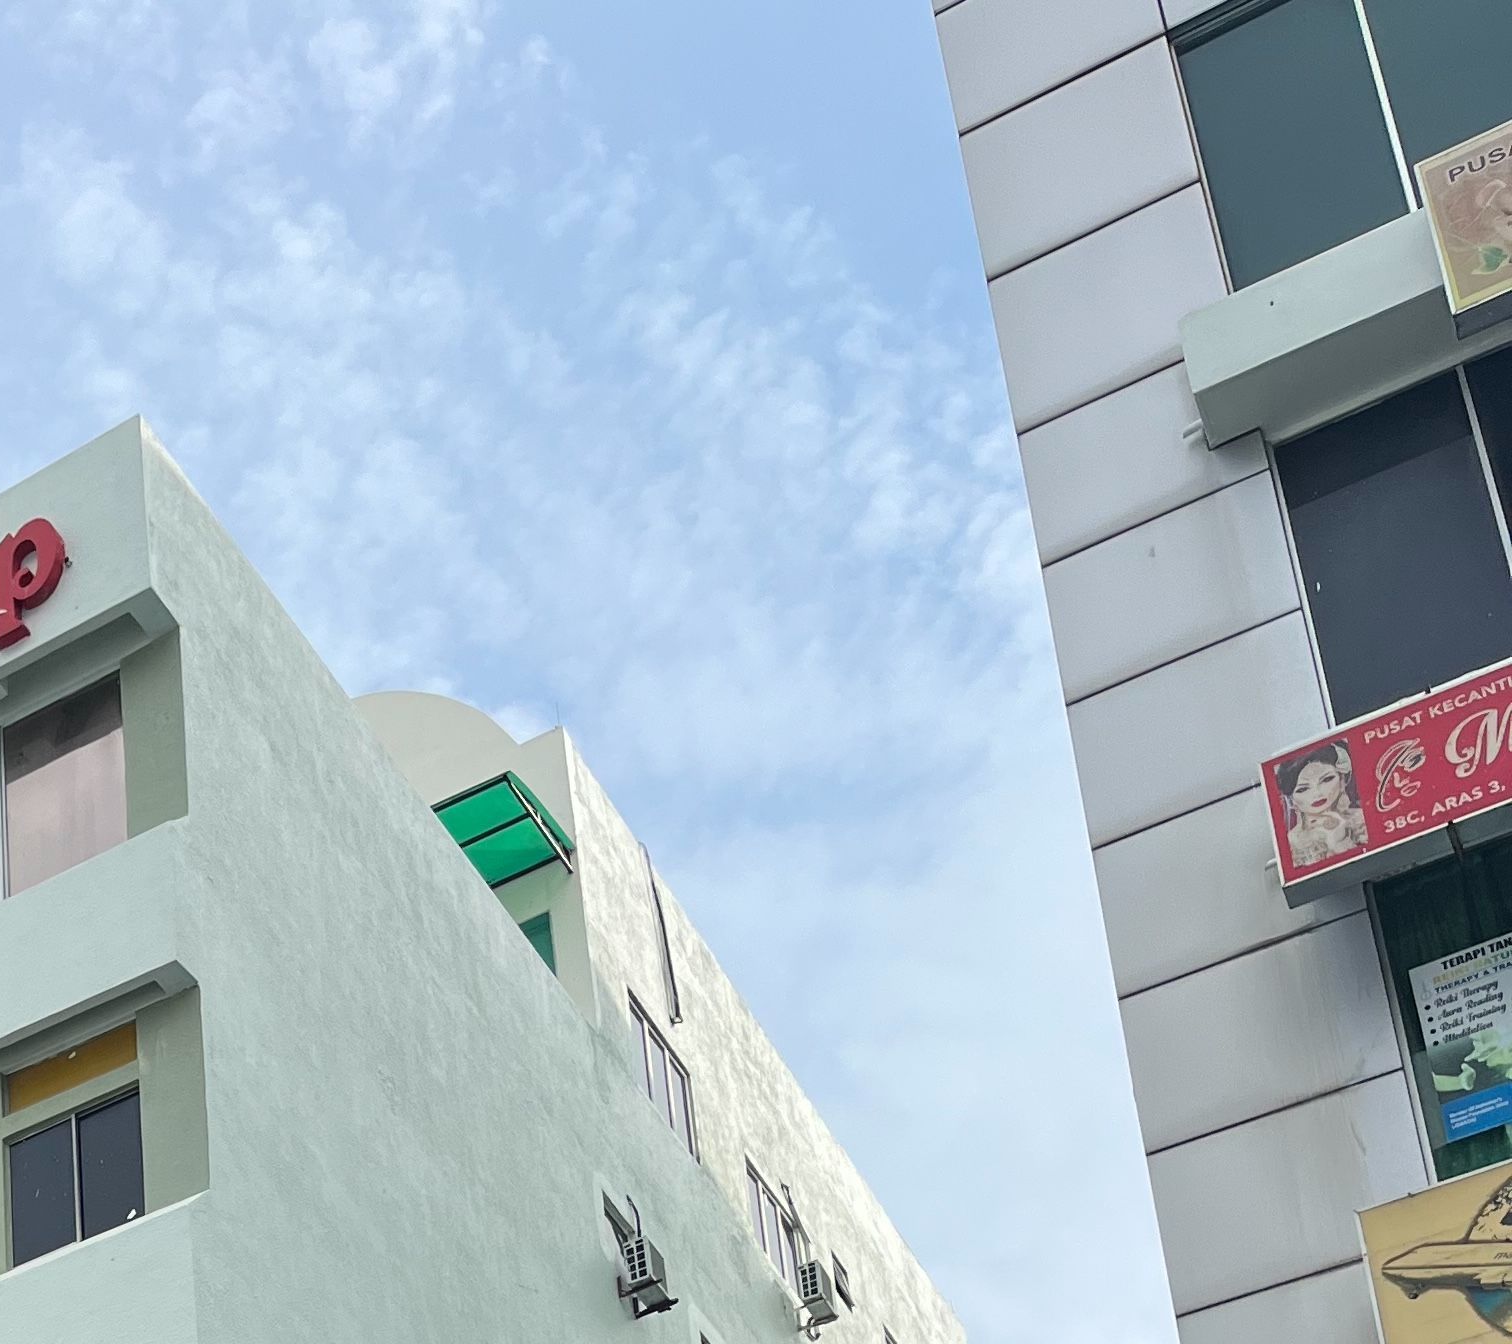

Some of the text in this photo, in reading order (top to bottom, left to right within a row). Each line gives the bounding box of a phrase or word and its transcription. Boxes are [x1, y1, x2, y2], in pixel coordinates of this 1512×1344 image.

[1448, 145, 1512, 183] PUS
[1364, 710, 1423, 744] PUSAT
[1432, 786, 1483, 816] ARAS
[1441, 947, 1486, 970] TERAPI
